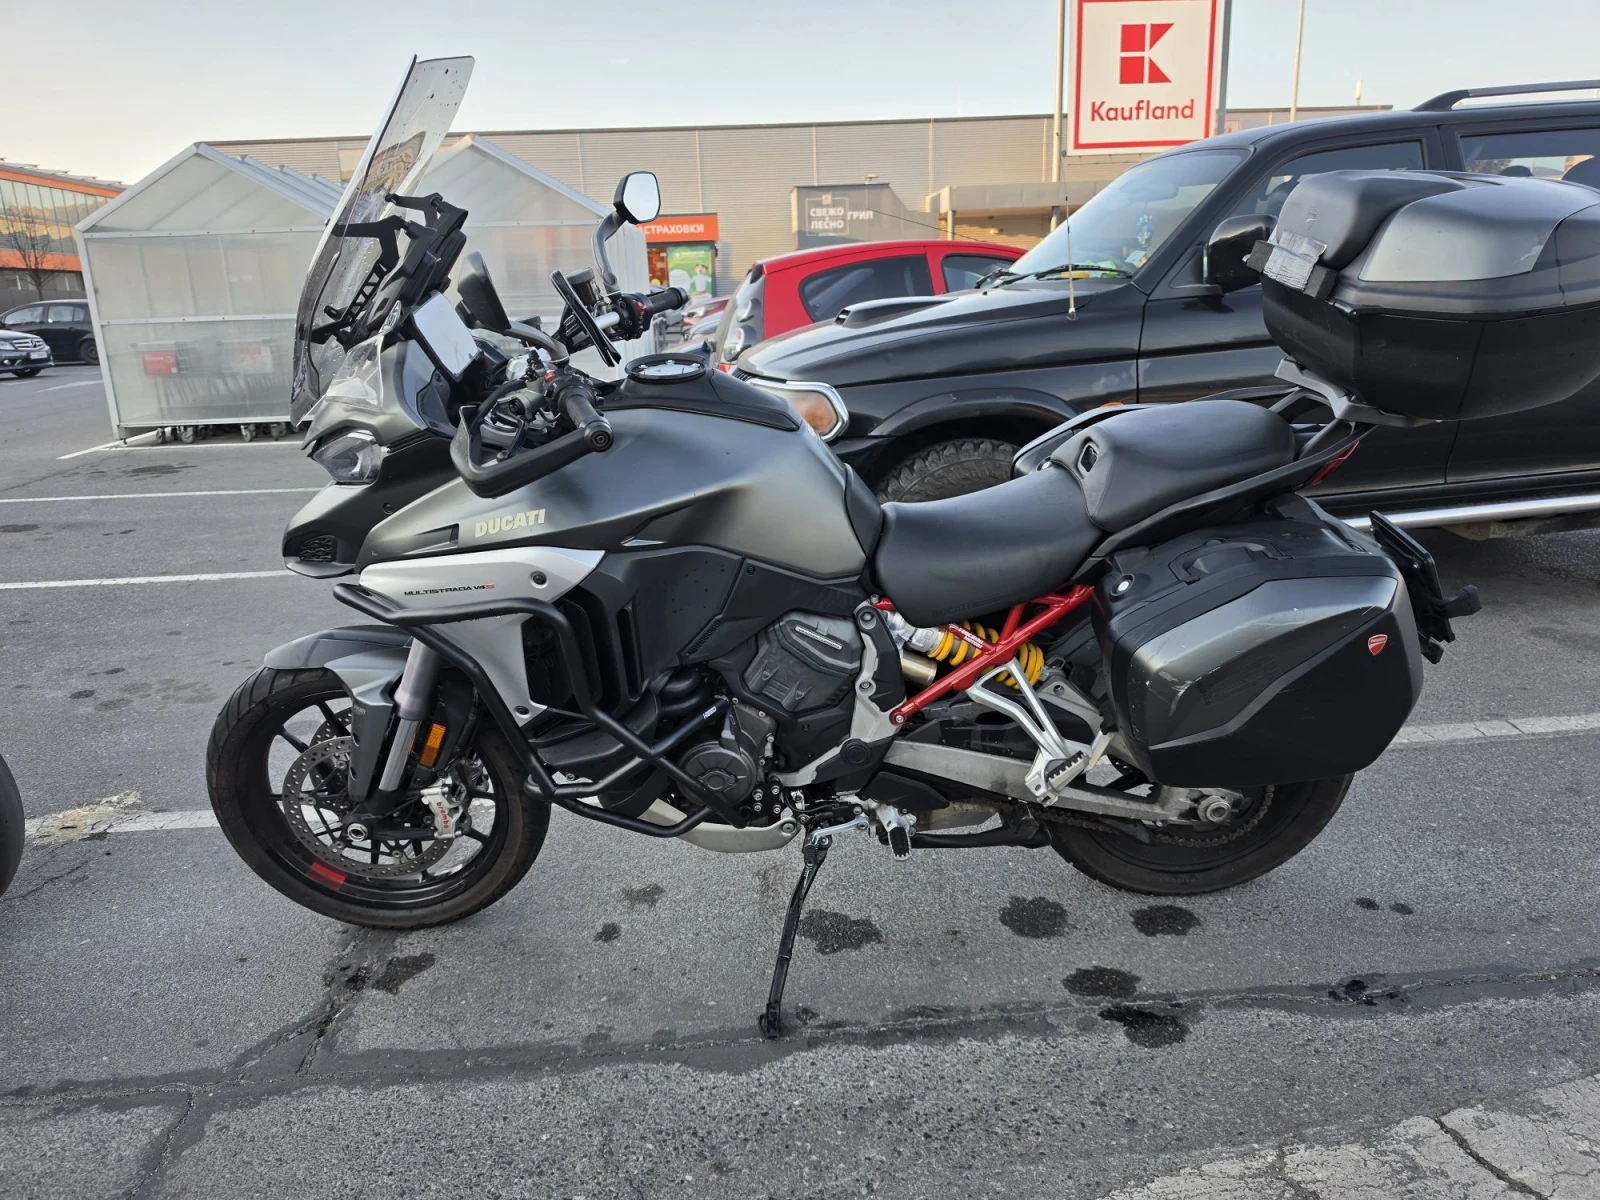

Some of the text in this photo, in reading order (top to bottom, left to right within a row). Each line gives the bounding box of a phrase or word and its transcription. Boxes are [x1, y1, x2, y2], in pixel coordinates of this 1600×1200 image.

[1091, 98, 1195, 121] Kaufland
[809, 207, 845, 217] СВЕЖО
[846, 210, 874, 220] ГРИЛ
[810, 219, 845, 230] ЛЕСНО
[474, 508, 546, 538] DUCATI
[404, 586, 472, 596] MULTISTRADA
[436, 801, 450, 829] brembo
